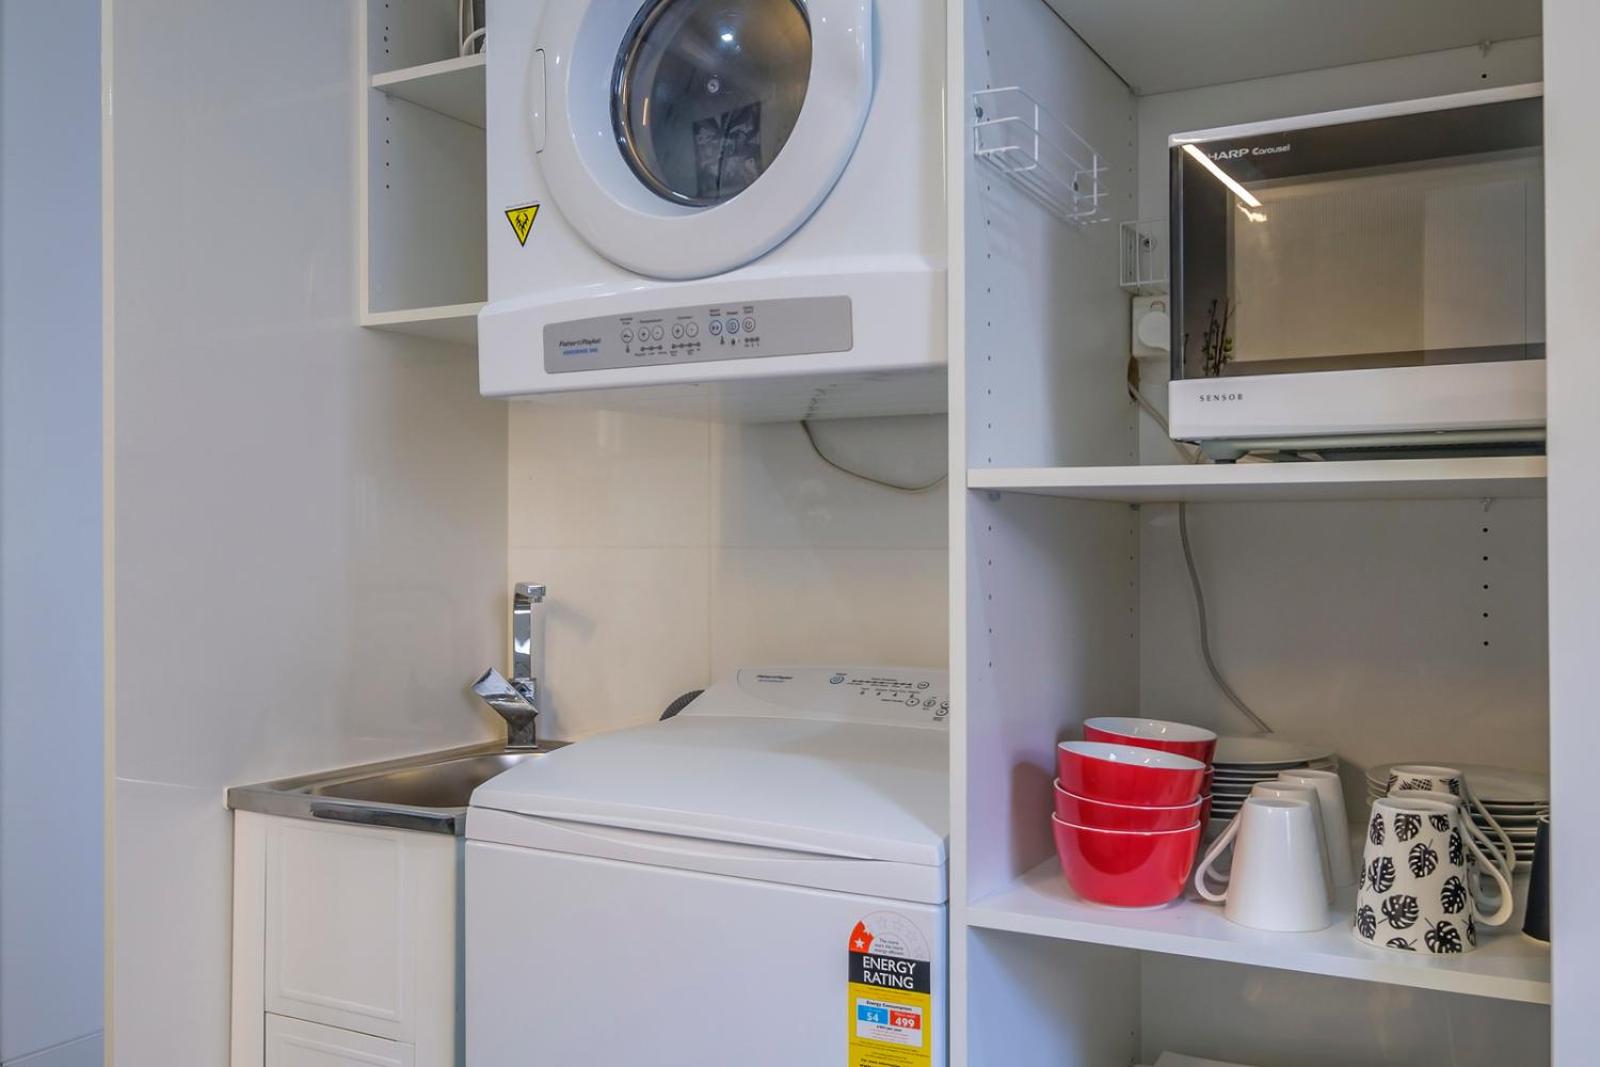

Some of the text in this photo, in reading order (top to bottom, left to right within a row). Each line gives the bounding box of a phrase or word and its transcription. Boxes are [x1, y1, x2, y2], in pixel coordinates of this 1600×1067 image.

[1206, 144, 1291, 161] HARP Carousel
[1199, 393, 1244, 402] SENSOR
[862, 956, 916, 975] ENERGY
[863, 970, 914, 989] RATING
[866, 1011, 879, 1022] 54
[895, 1016, 915, 1028] 499
